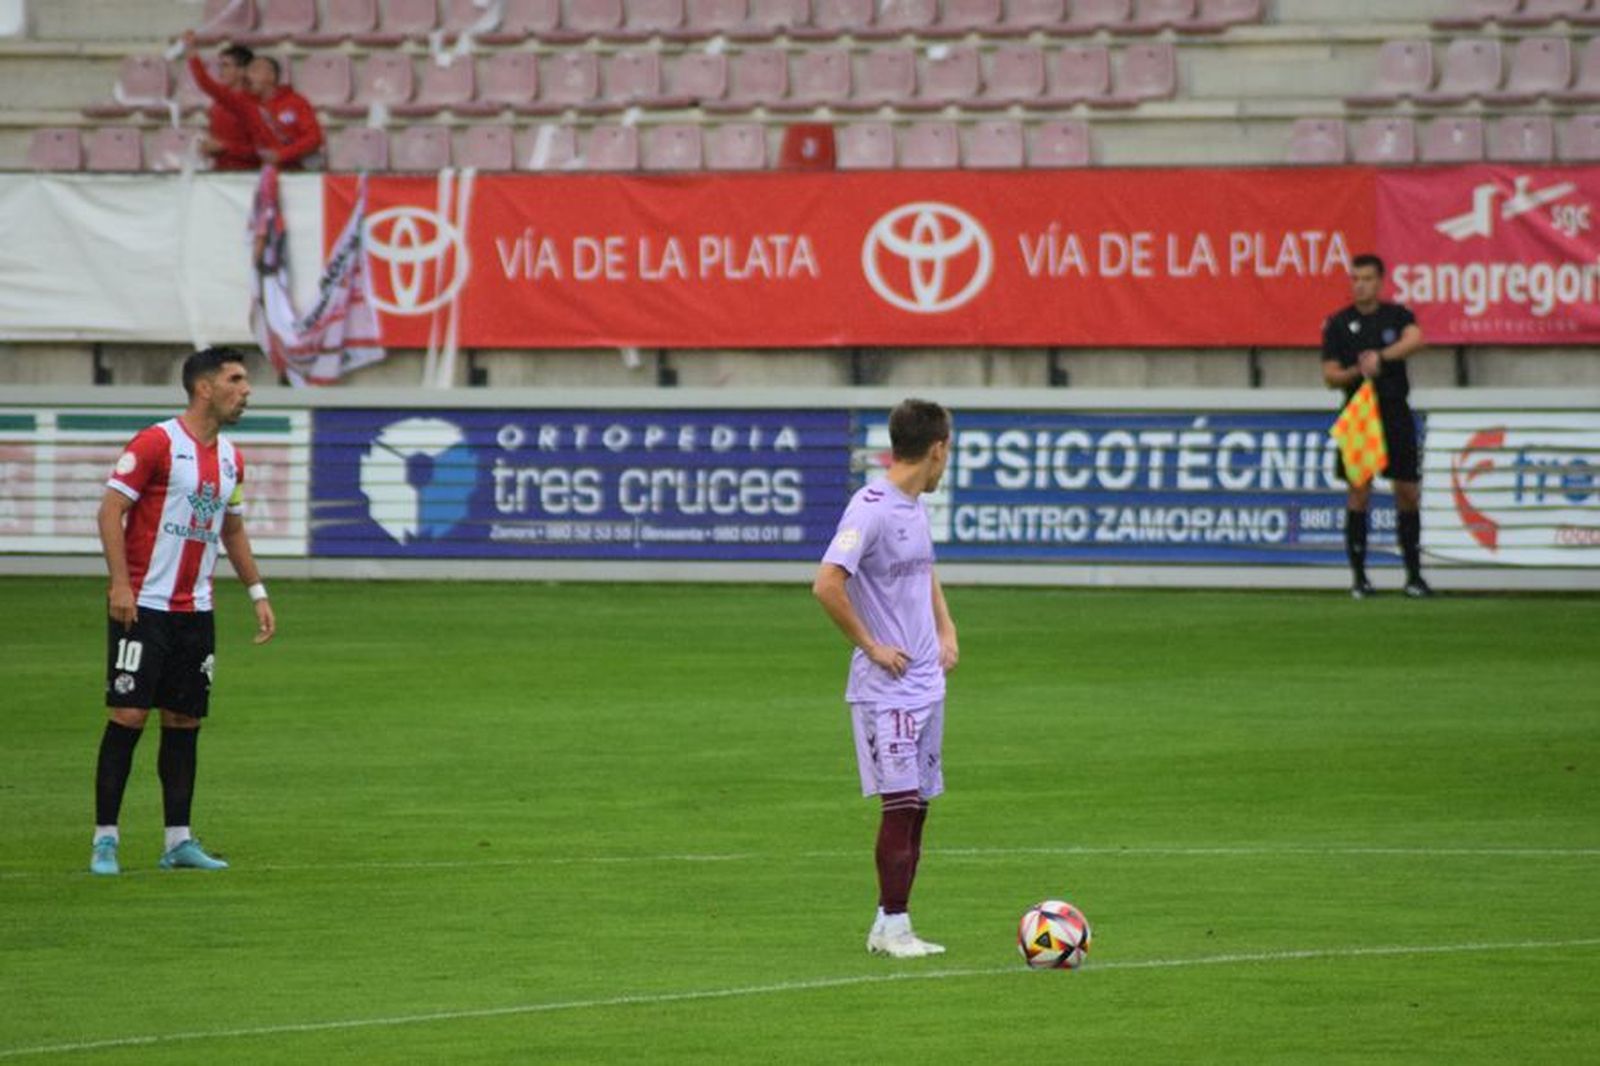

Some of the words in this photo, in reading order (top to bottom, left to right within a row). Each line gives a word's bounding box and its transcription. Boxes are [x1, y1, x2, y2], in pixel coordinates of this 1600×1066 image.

[495, 227, 563, 281] VÍA
[573, 236, 627, 281] DE
[638, 236, 688, 281] LA
[699, 235, 820, 280] PLATA
[1018, 221, 1089, 278] VÍA
[1099, 232, 1154, 278] DE
[1166, 232, 1220, 278] LA
[1229, 231, 1352, 277] PLATA
[1392, 259, 1600, 317] sangregor
[496, 424, 798, 451] ORTOPEDIA
[957, 417, 1396, 490] PSICOTÉCNIC
[491, 458, 602, 514] tres
[618, 468, 803, 514] cruces
[954, 505, 1089, 542] CENTRO
[1094, 505, 1288, 543] ZAMORANO
[1300, 508, 1331, 530] 980
[115, 638, 143, 673] 10
